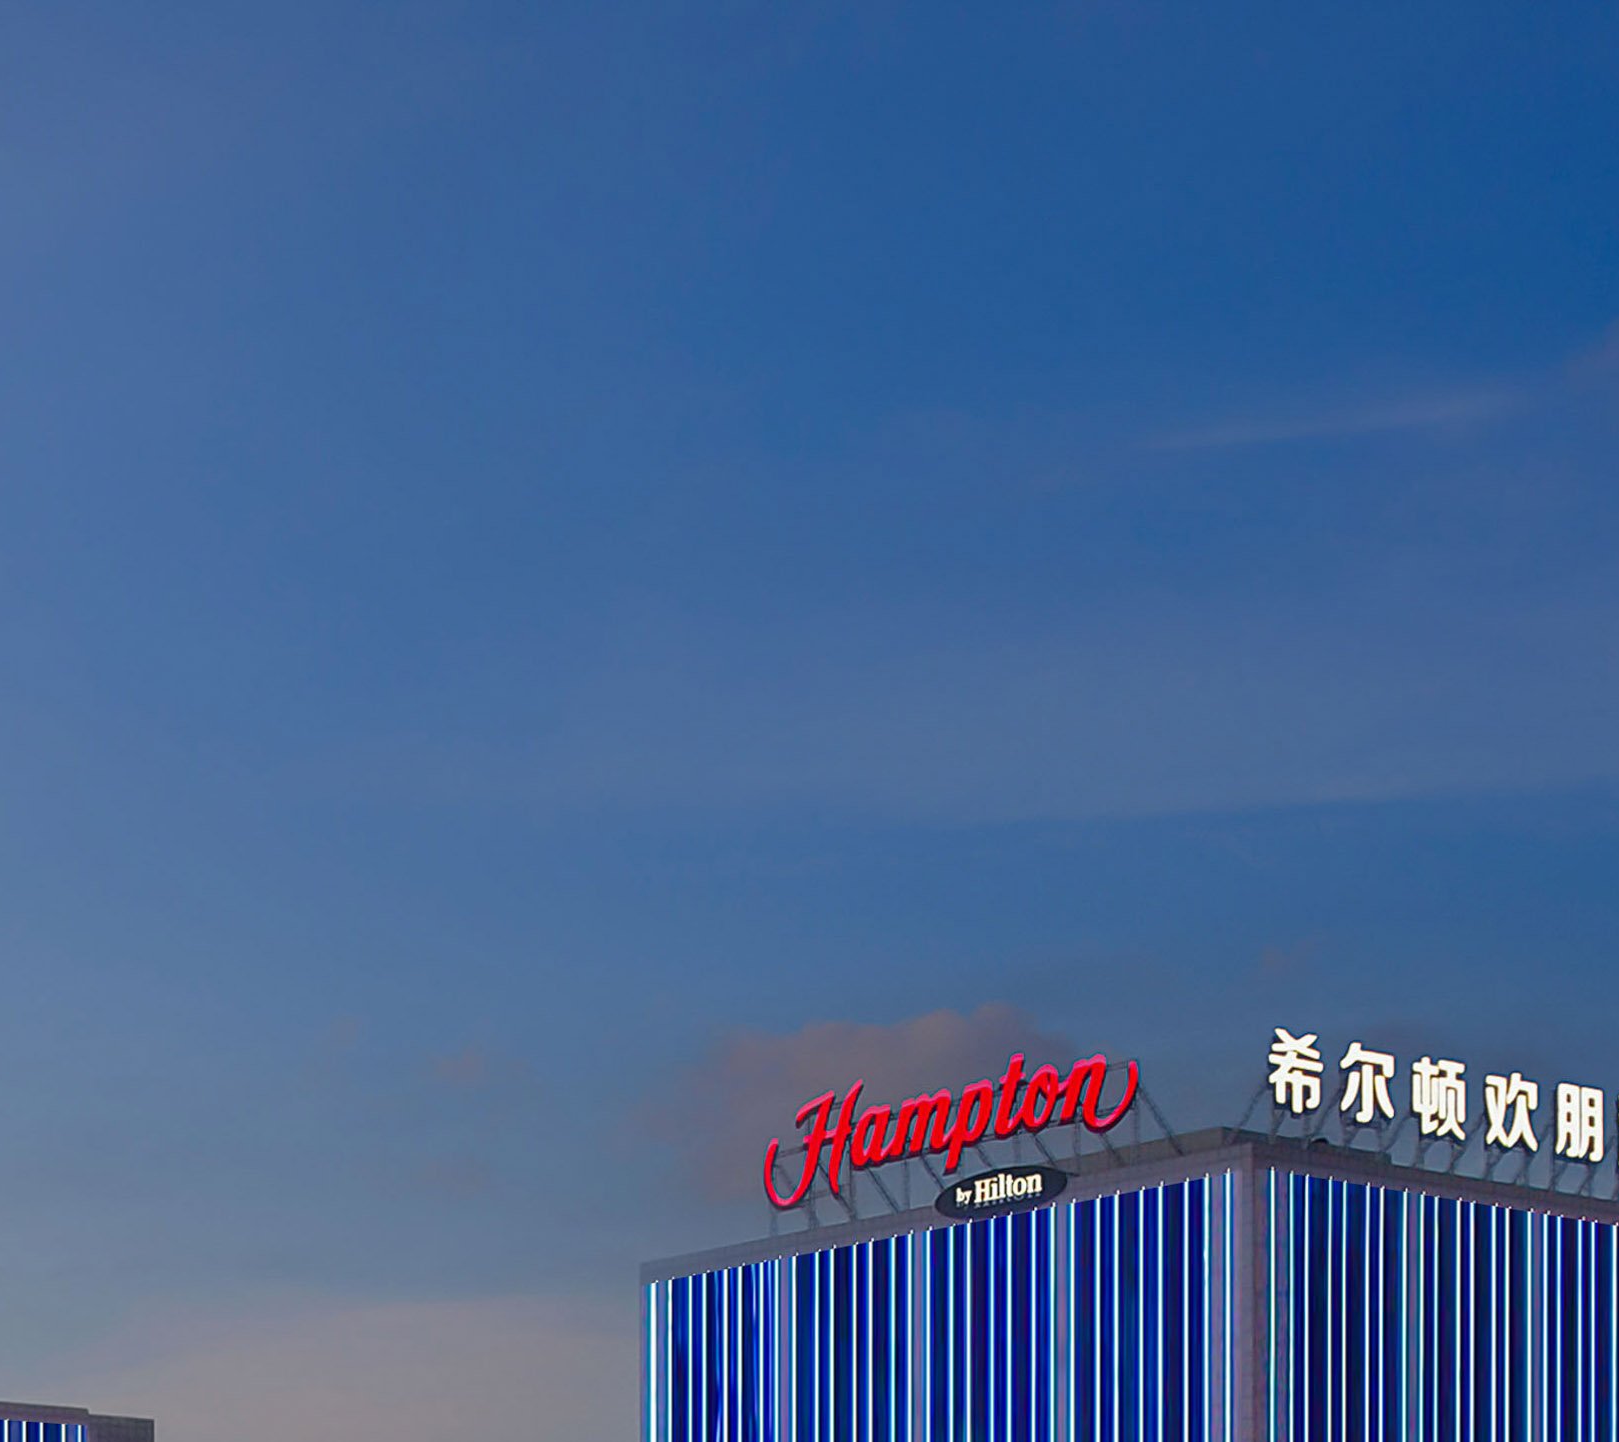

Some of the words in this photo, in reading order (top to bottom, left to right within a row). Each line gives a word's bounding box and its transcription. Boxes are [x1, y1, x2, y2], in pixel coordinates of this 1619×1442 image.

[763, 1052, 1139, 1208] Hampton
[956, 1187, 973, 1205] by
[974, 1173, 1043, 1203] Hilton
